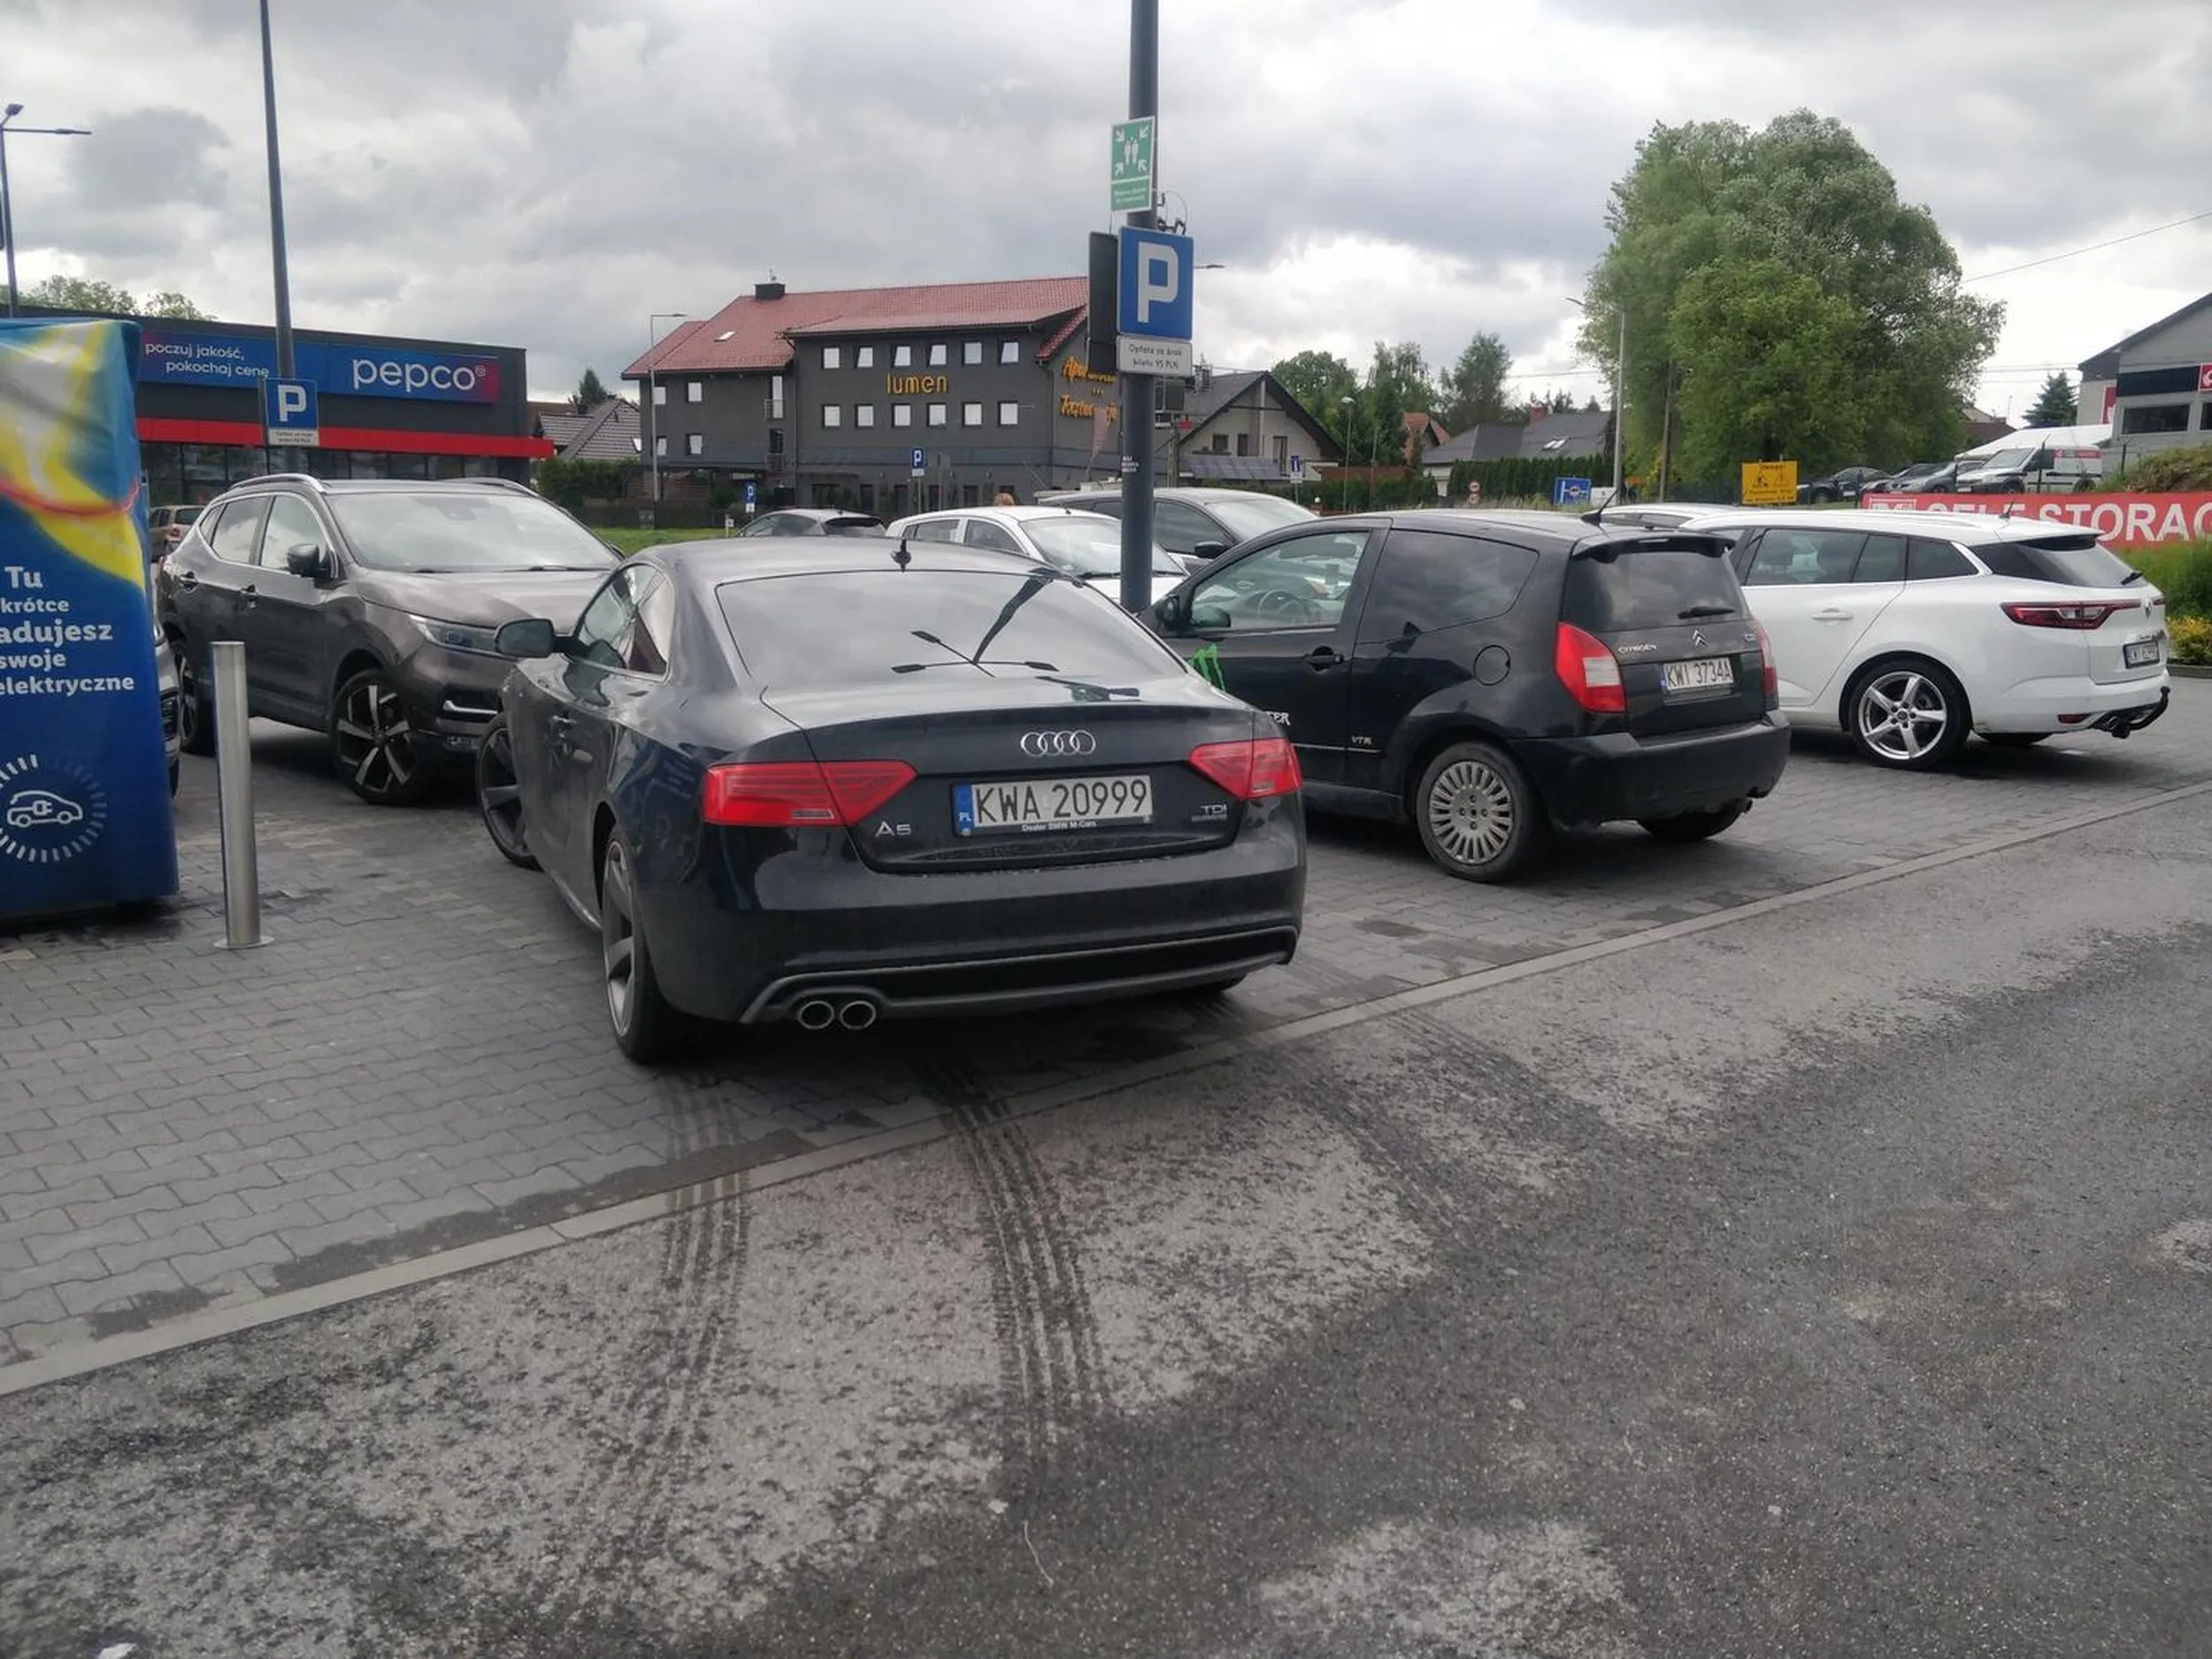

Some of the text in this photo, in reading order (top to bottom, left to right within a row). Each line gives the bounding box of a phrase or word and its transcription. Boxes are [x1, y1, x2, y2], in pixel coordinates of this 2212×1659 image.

[1137, 241, 1179, 324] P
[145, 342, 245, 361] poczuj jakość,
[165, 360, 269, 379] pokochaj cenę
[353, 358, 476, 393] pepco
[887, 373, 948, 394] lumen
[278, 384, 307, 422] P
[4, 565, 43, 588] Tu
[0, 597, 70, 613] krótce
[0, 618, 113, 647] adujesz
[0, 649, 66, 672] swoje
[1694, 660, 1732, 684] 3734A
[0, 676, 134, 696] elektryczne
[975, 779, 1148, 824] KWA 20999
[1201, 803, 1228, 815] TDI
[959, 812, 972, 823] PL
[875, 821, 911, 837] A5
